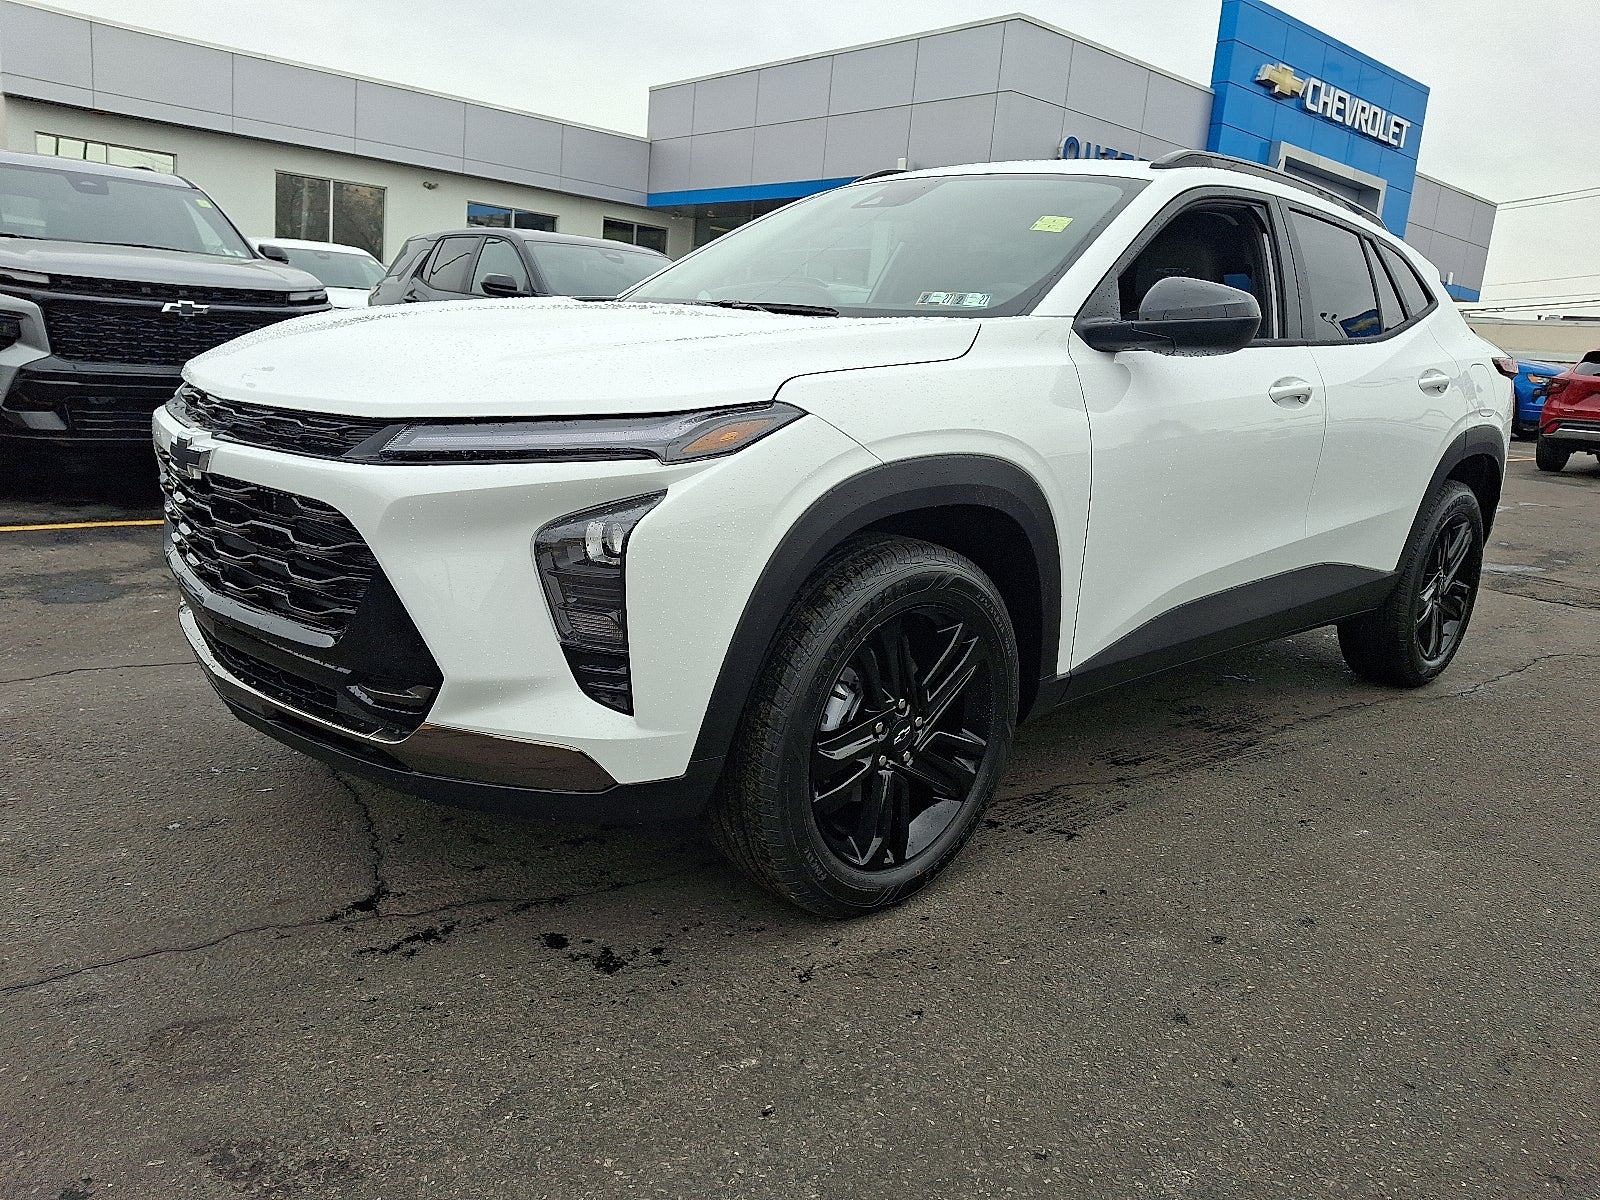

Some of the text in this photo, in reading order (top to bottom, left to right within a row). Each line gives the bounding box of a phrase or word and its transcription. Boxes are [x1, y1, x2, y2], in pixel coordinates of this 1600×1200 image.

[1305, 77, 1411, 148] CHEVROLET
[921, 293, 953, 304] 2 27
[956, 294, 989, 305] 2 27
